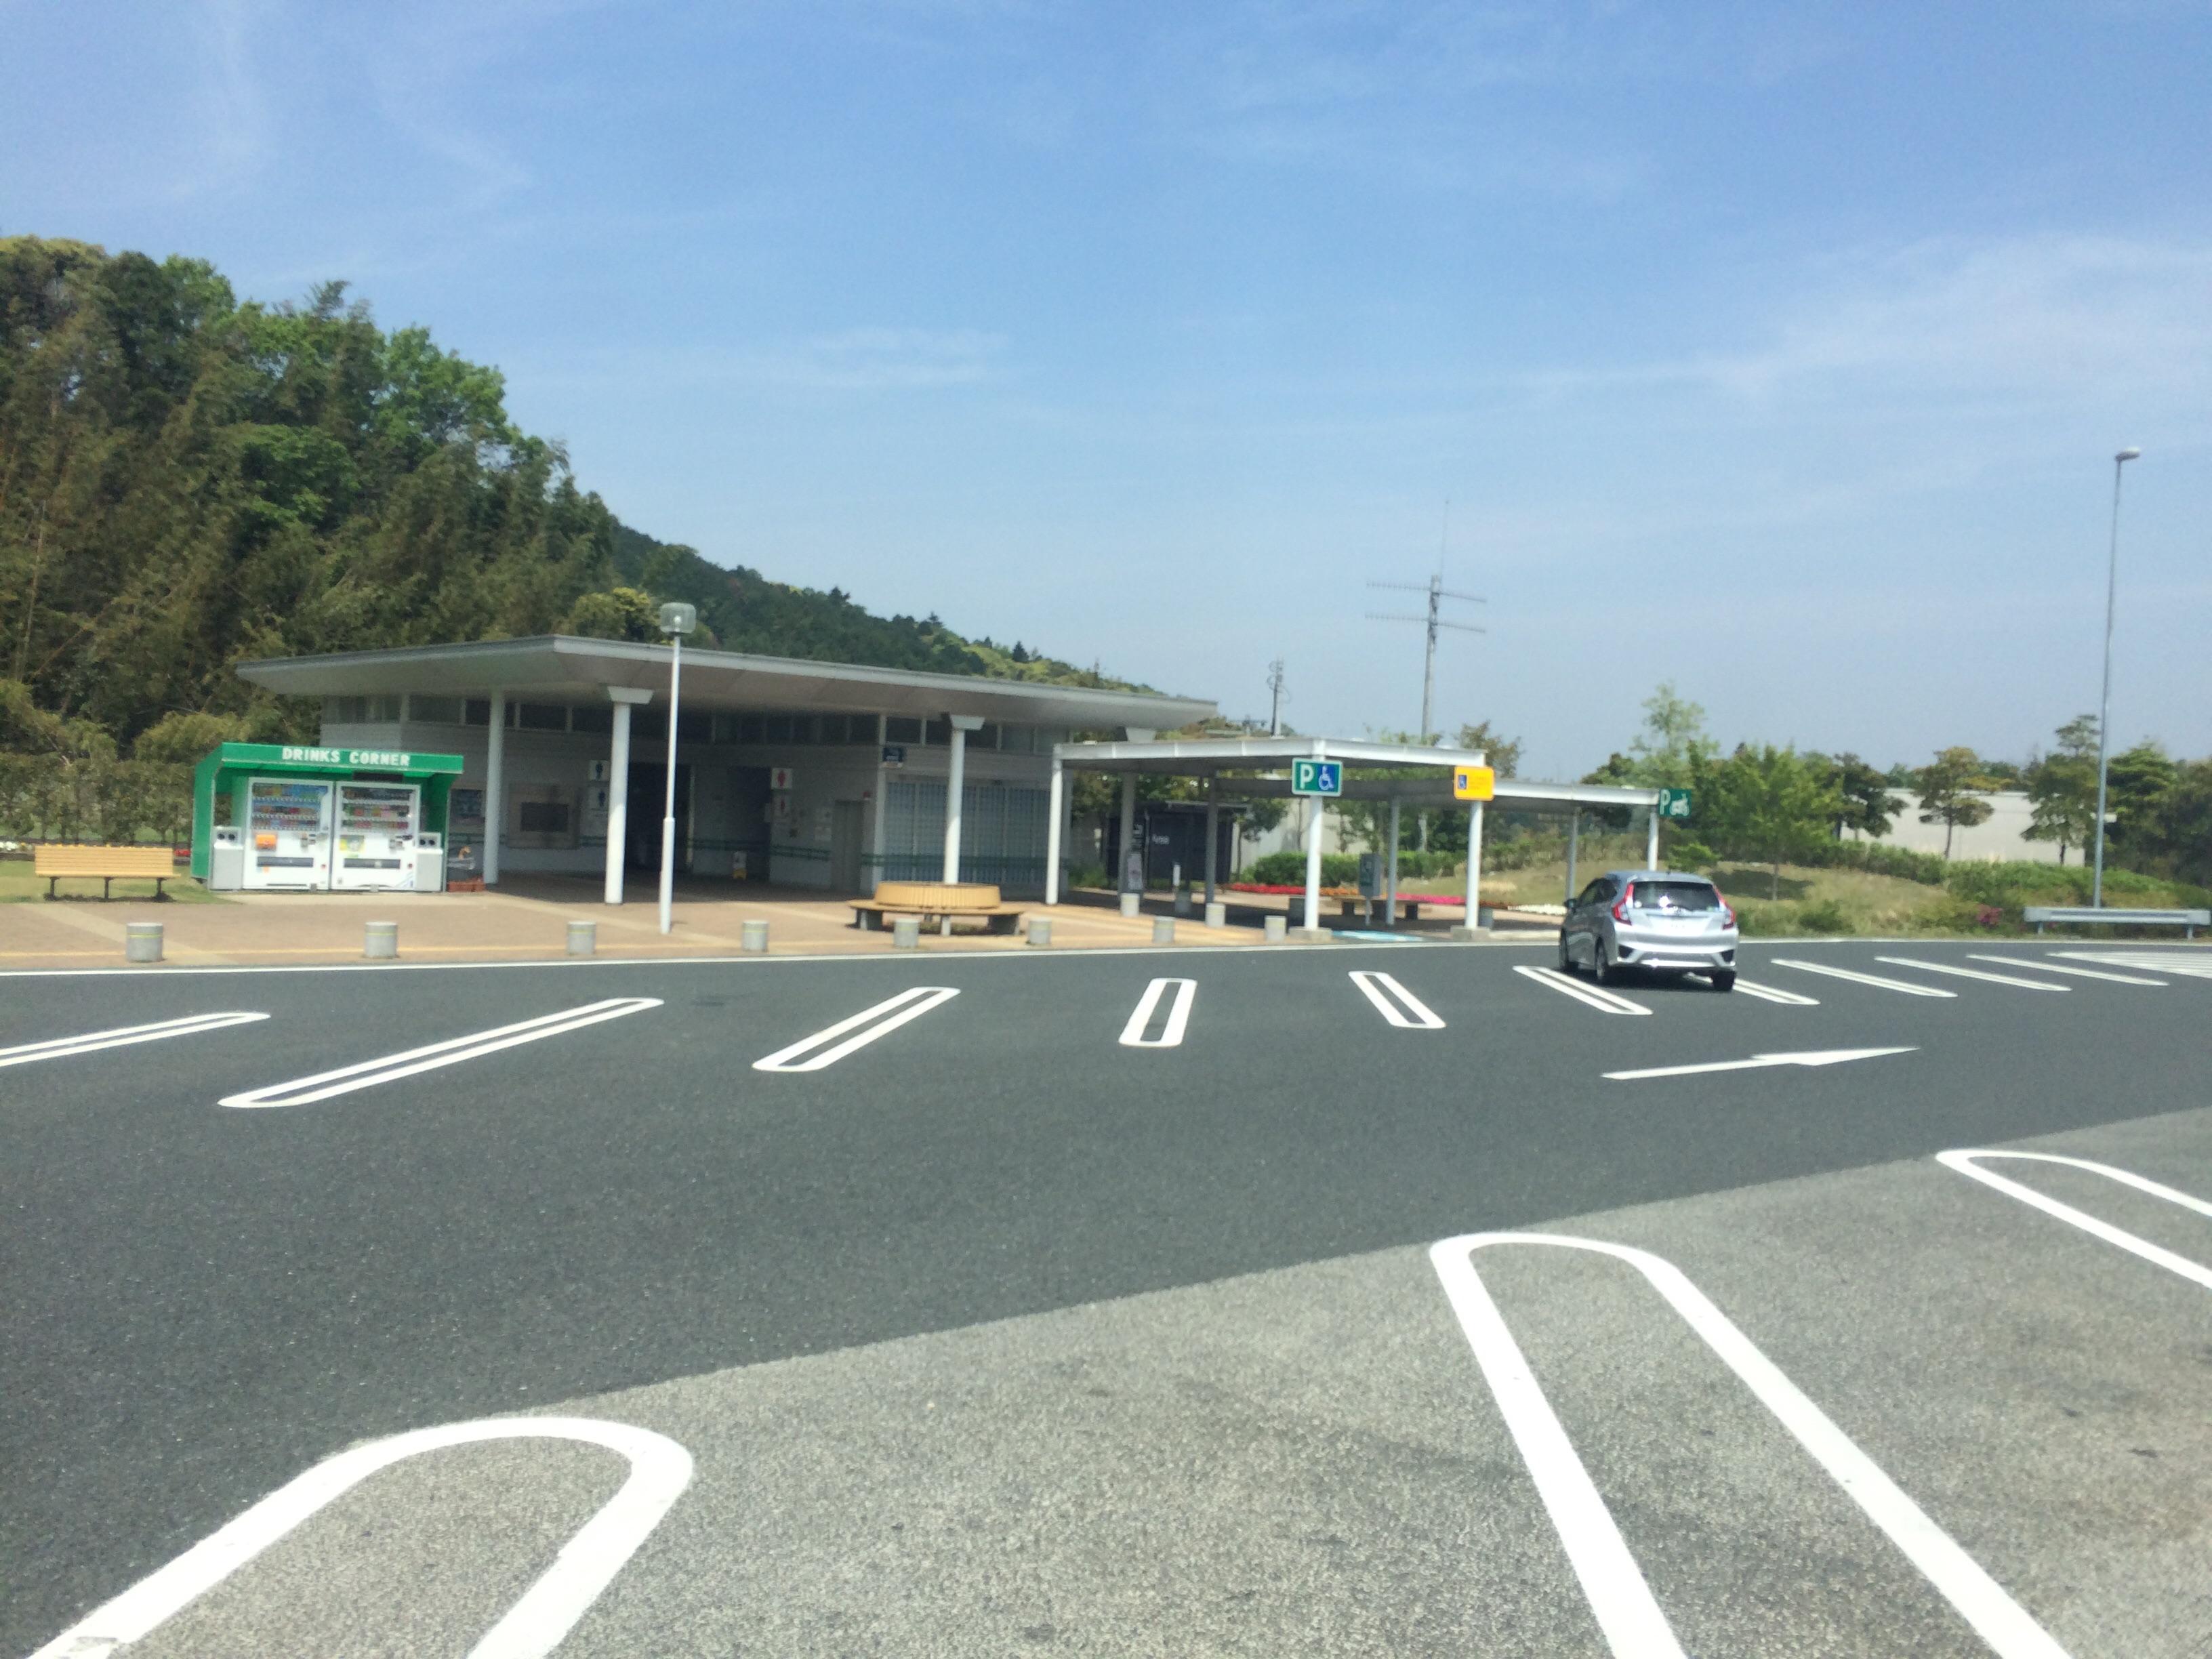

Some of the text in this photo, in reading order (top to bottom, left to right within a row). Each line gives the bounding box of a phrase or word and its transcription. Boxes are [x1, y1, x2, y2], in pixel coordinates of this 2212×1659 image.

[282, 747, 410, 766] DRINKS CORNER
[1300, 764, 1314, 790] P
[1660, 789, 1671, 815] P
